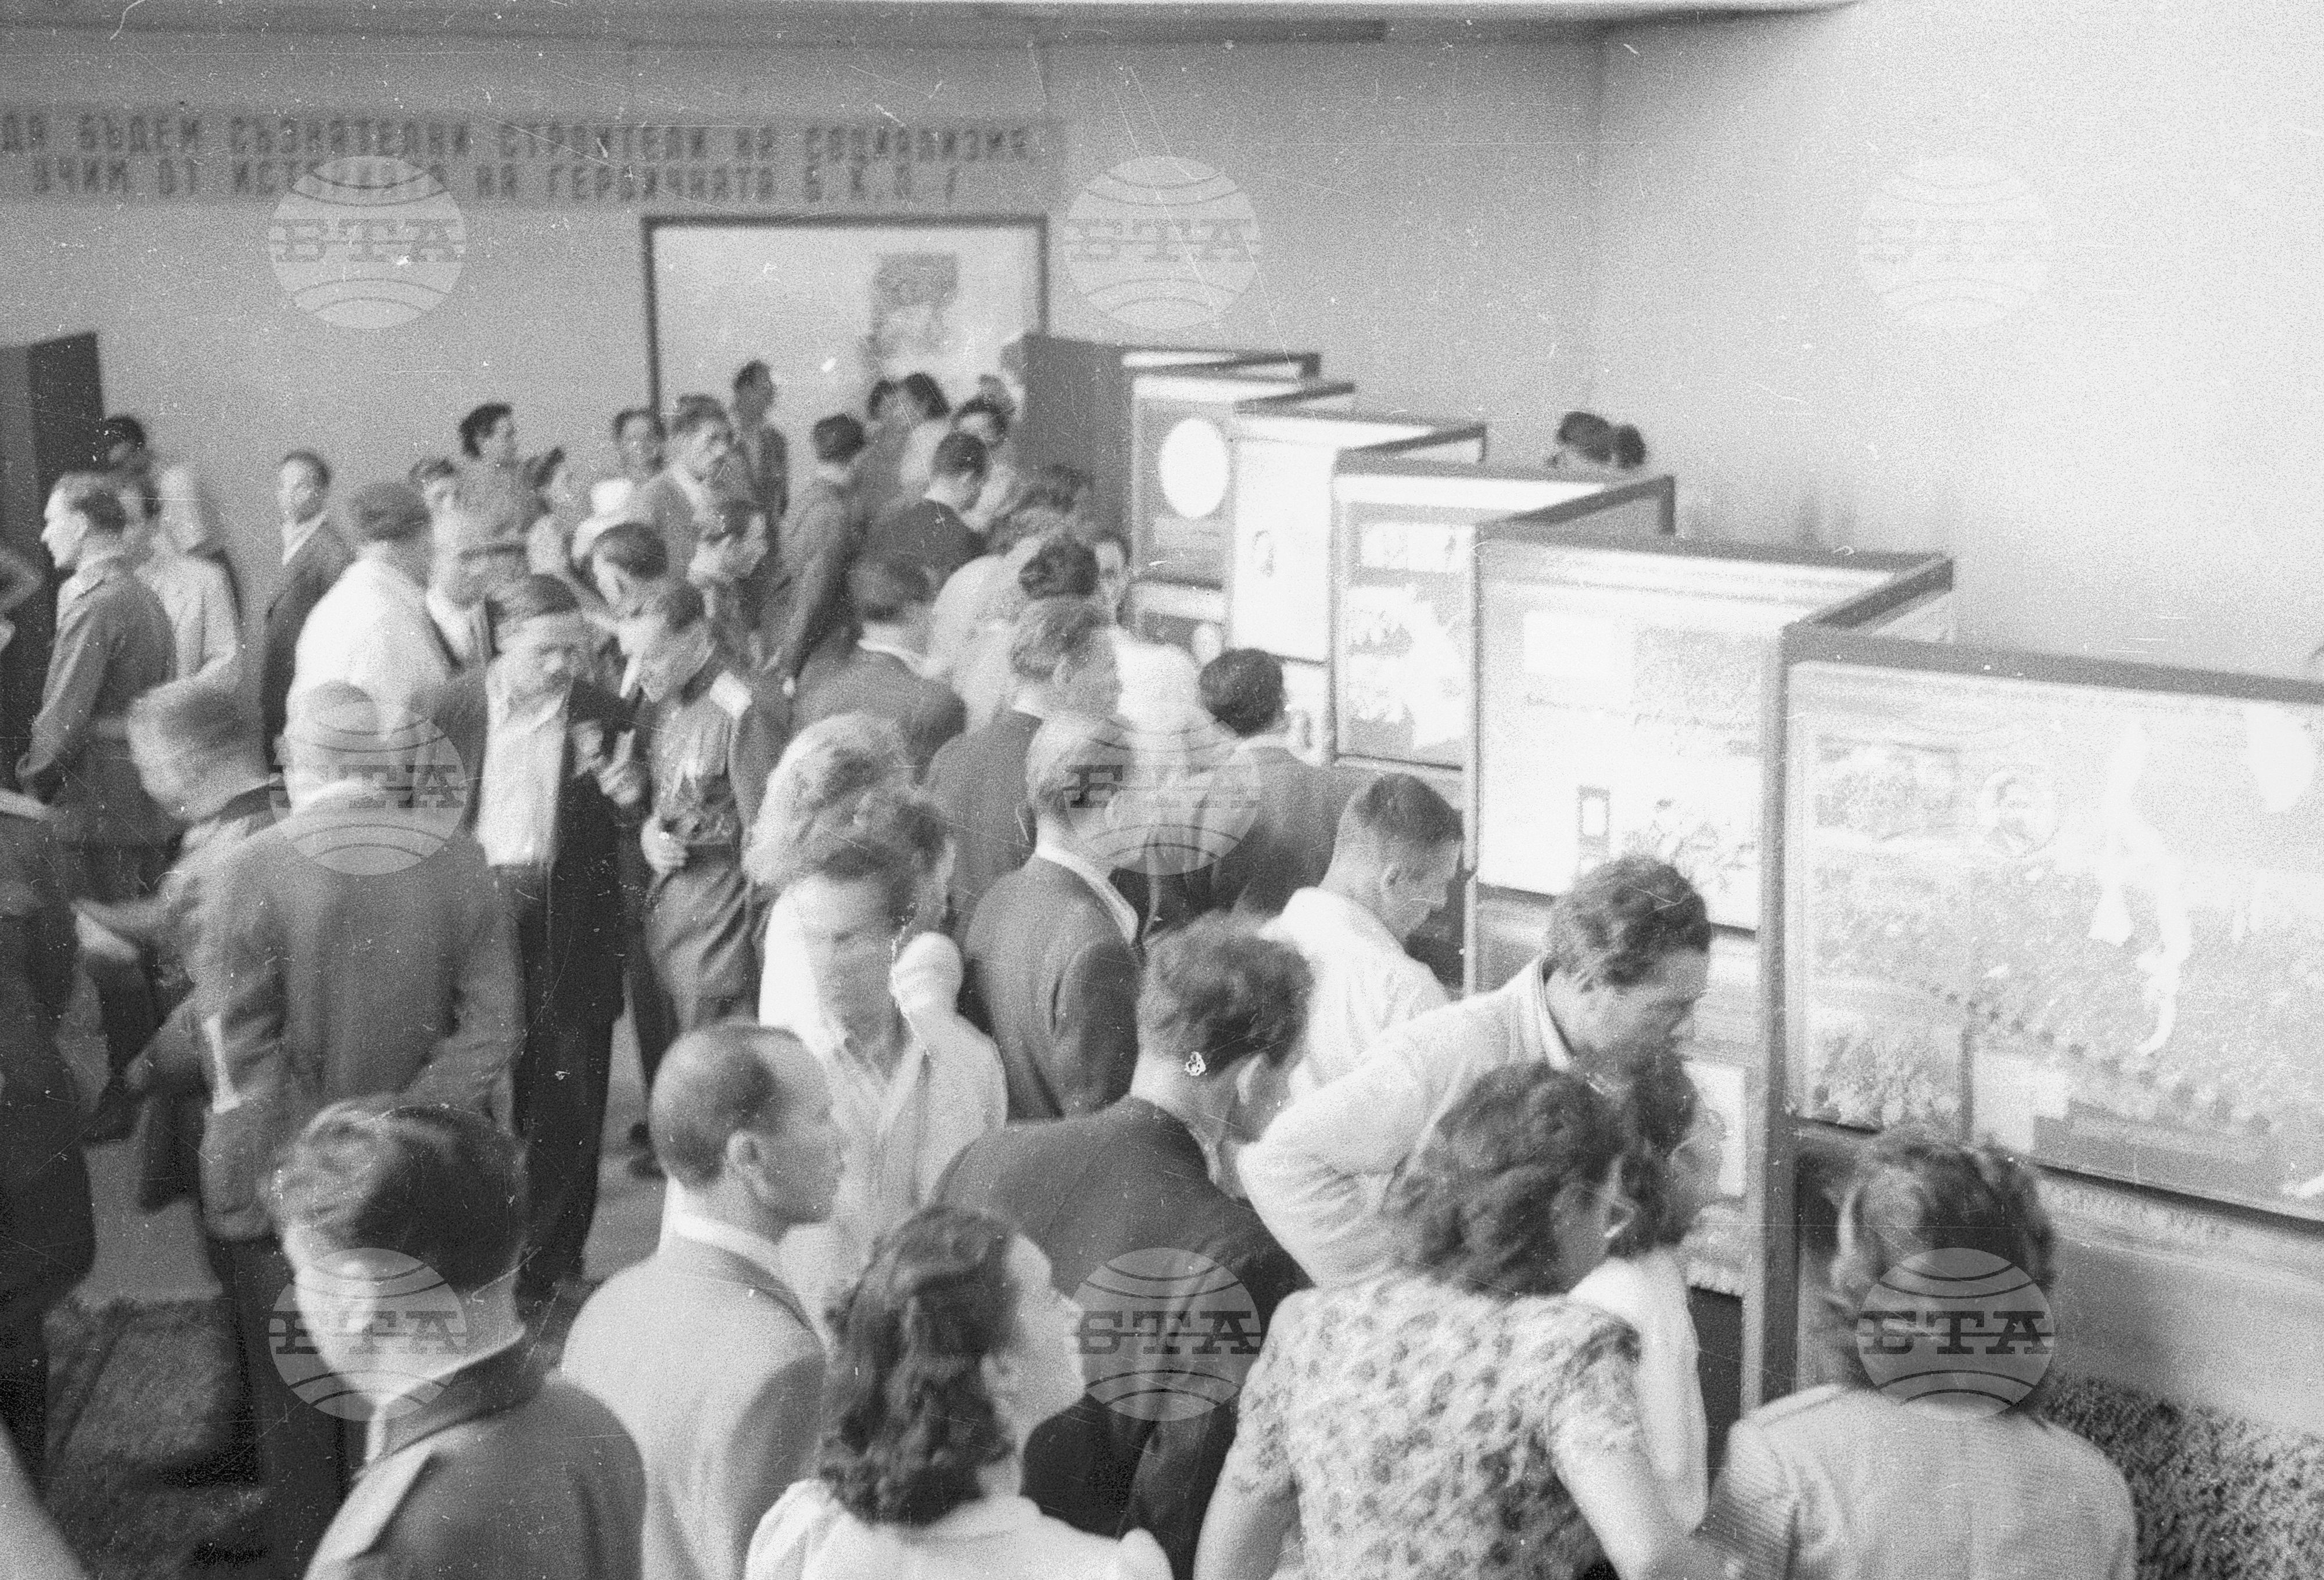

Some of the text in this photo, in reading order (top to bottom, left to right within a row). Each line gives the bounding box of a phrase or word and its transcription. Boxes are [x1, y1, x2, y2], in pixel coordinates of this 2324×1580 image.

[2, 112, 48, 153] ДА
[79, 113, 202, 154] БЪДЕМ
[229, 115, 470, 157] СЪЗНАТЕЛНИ
[498, 119, 707, 159] СТРОИТЕЛИ
[735, 124, 776, 160] НА
[157, 156, 199, 198] ОТ
[475, 163, 518, 200] НА
